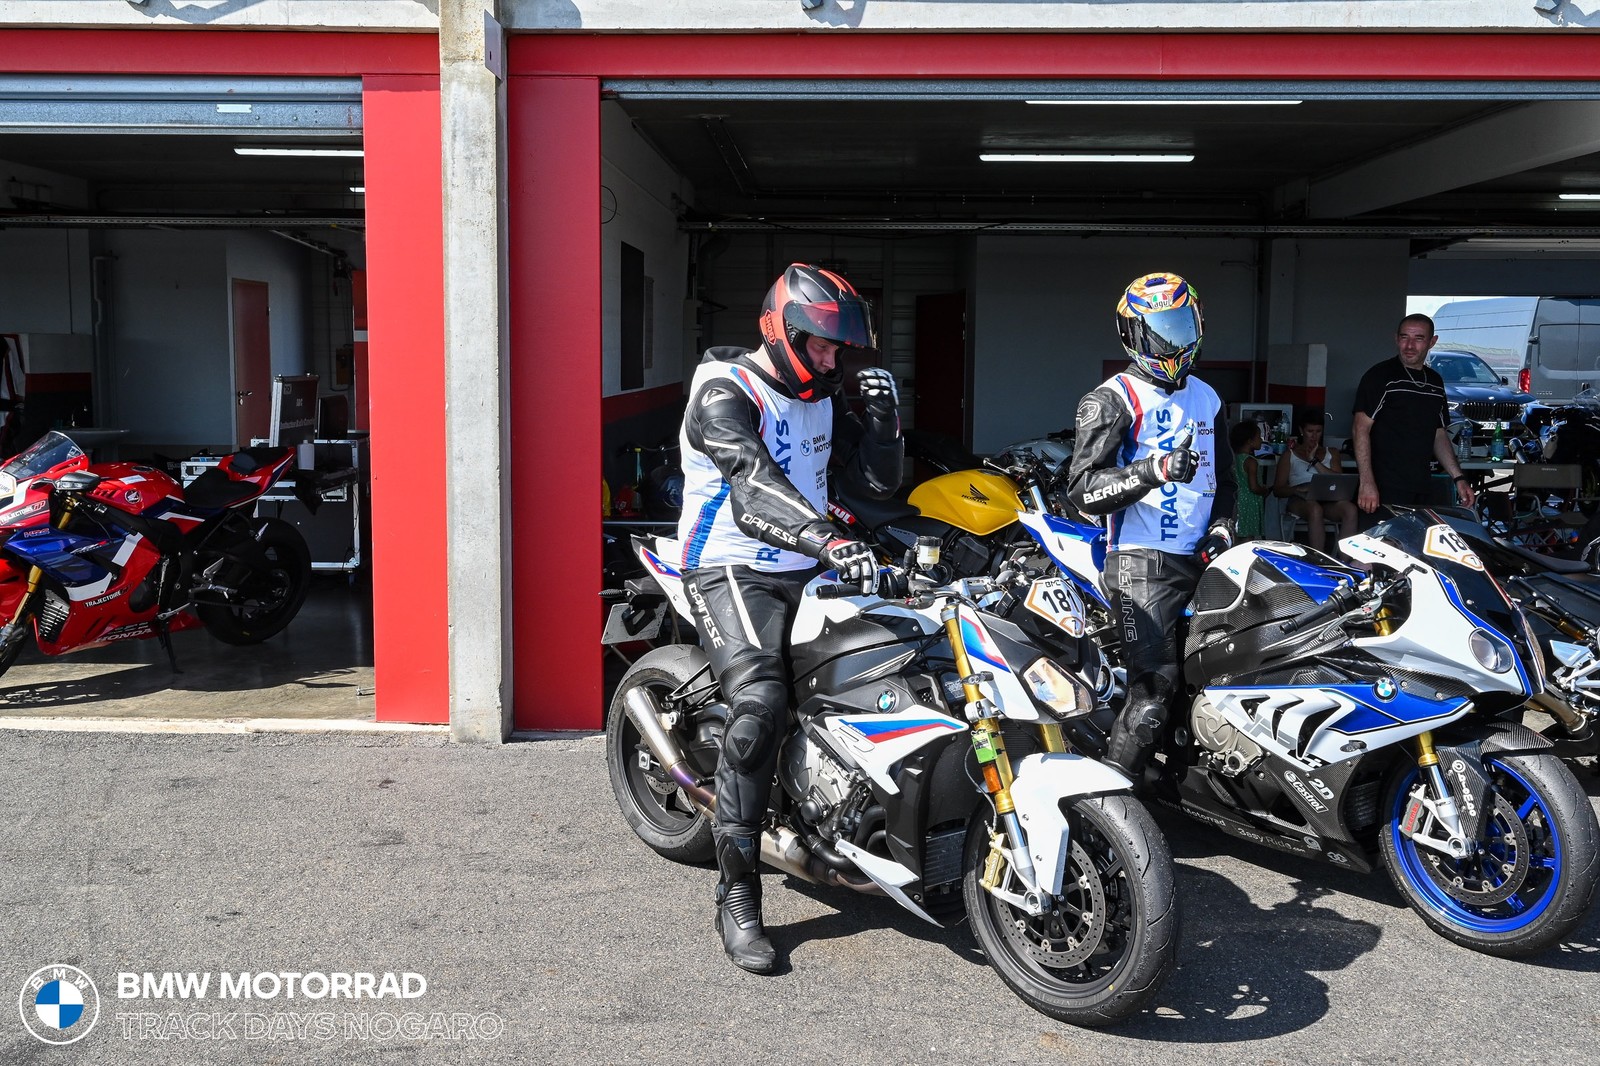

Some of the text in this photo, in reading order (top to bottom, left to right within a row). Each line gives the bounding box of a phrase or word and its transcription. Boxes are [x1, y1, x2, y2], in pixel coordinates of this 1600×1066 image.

[812, 433, 826, 445] BMW
[1156, 409, 1176, 451] AYS
[776, 418, 792, 475] AYS
[1082, 474, 1141, 505] BERING
[827, 501, 851, 525] TUL
[1159, 483, 1179, 542] TRAC
[739, 512, 798, 547] DAINESE
[1042, 588, 1081, 614] 181
[1118, 554, 1138, 643] BERING
[688, 583, 726, 650] DAINESE
[95, 627, 153, 643] HONDA
[1292, 781, 1324, 811] Castrol
[1308, 778, 1335, 800] 2D
[1182, 807, 1227, 827] Motorrad
[1404, 802, 1420, 833] brembo
